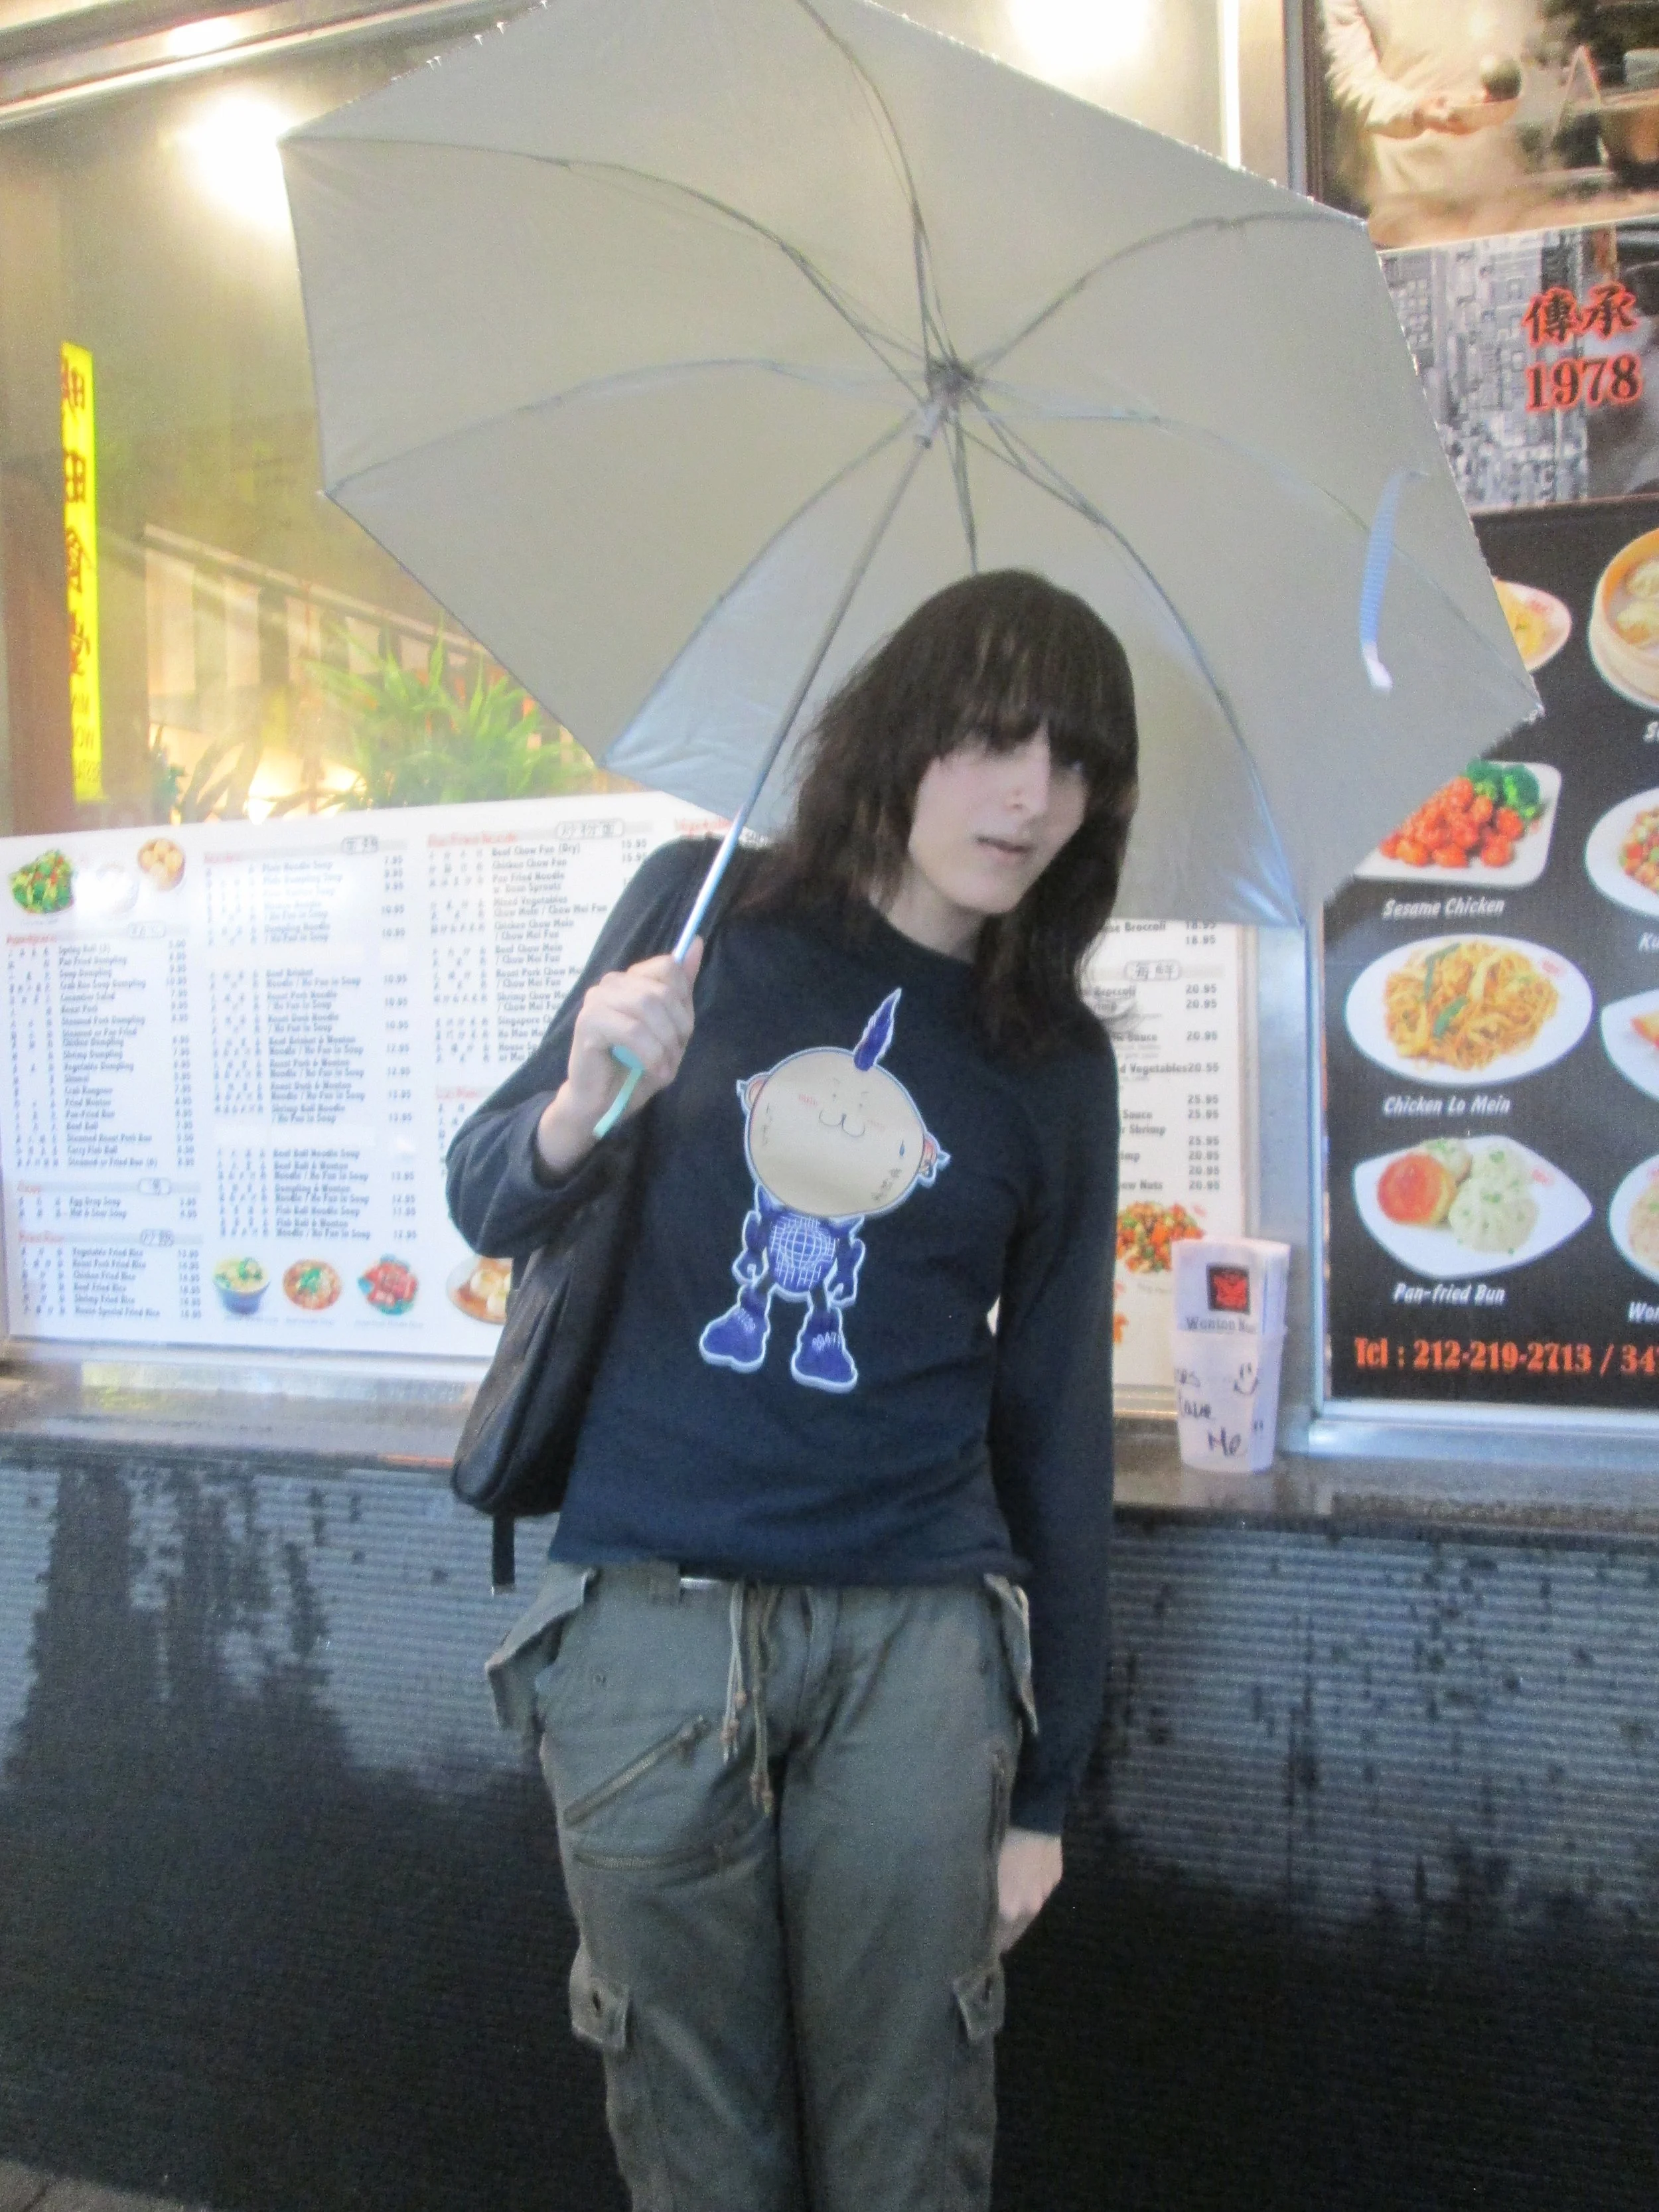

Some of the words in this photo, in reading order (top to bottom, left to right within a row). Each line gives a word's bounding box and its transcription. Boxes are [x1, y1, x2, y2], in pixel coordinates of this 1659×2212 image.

[1524, 285, 1639, 348] 傳承
[1526, 353, 1643, 411] 1978
[1382, 899, 1440, 919] Sesame
[1445, 897, 1504, 917] Chicken
[1125, 922, 1166, 932] Broccoli
[1123, 1110, 1153, 1119] Sauce
[1384, 1096, 1442, 1116] Chicken
[1448, 1097, 1465, 1113] Lo
[1471, 1096, 1511, 1114] Mein
[1475, 1285, 1505, 1303] Bun
[1354, 1337, 1388, 1370] Tel
[1413, 1339, 1591, 1373] 212-219-2713
